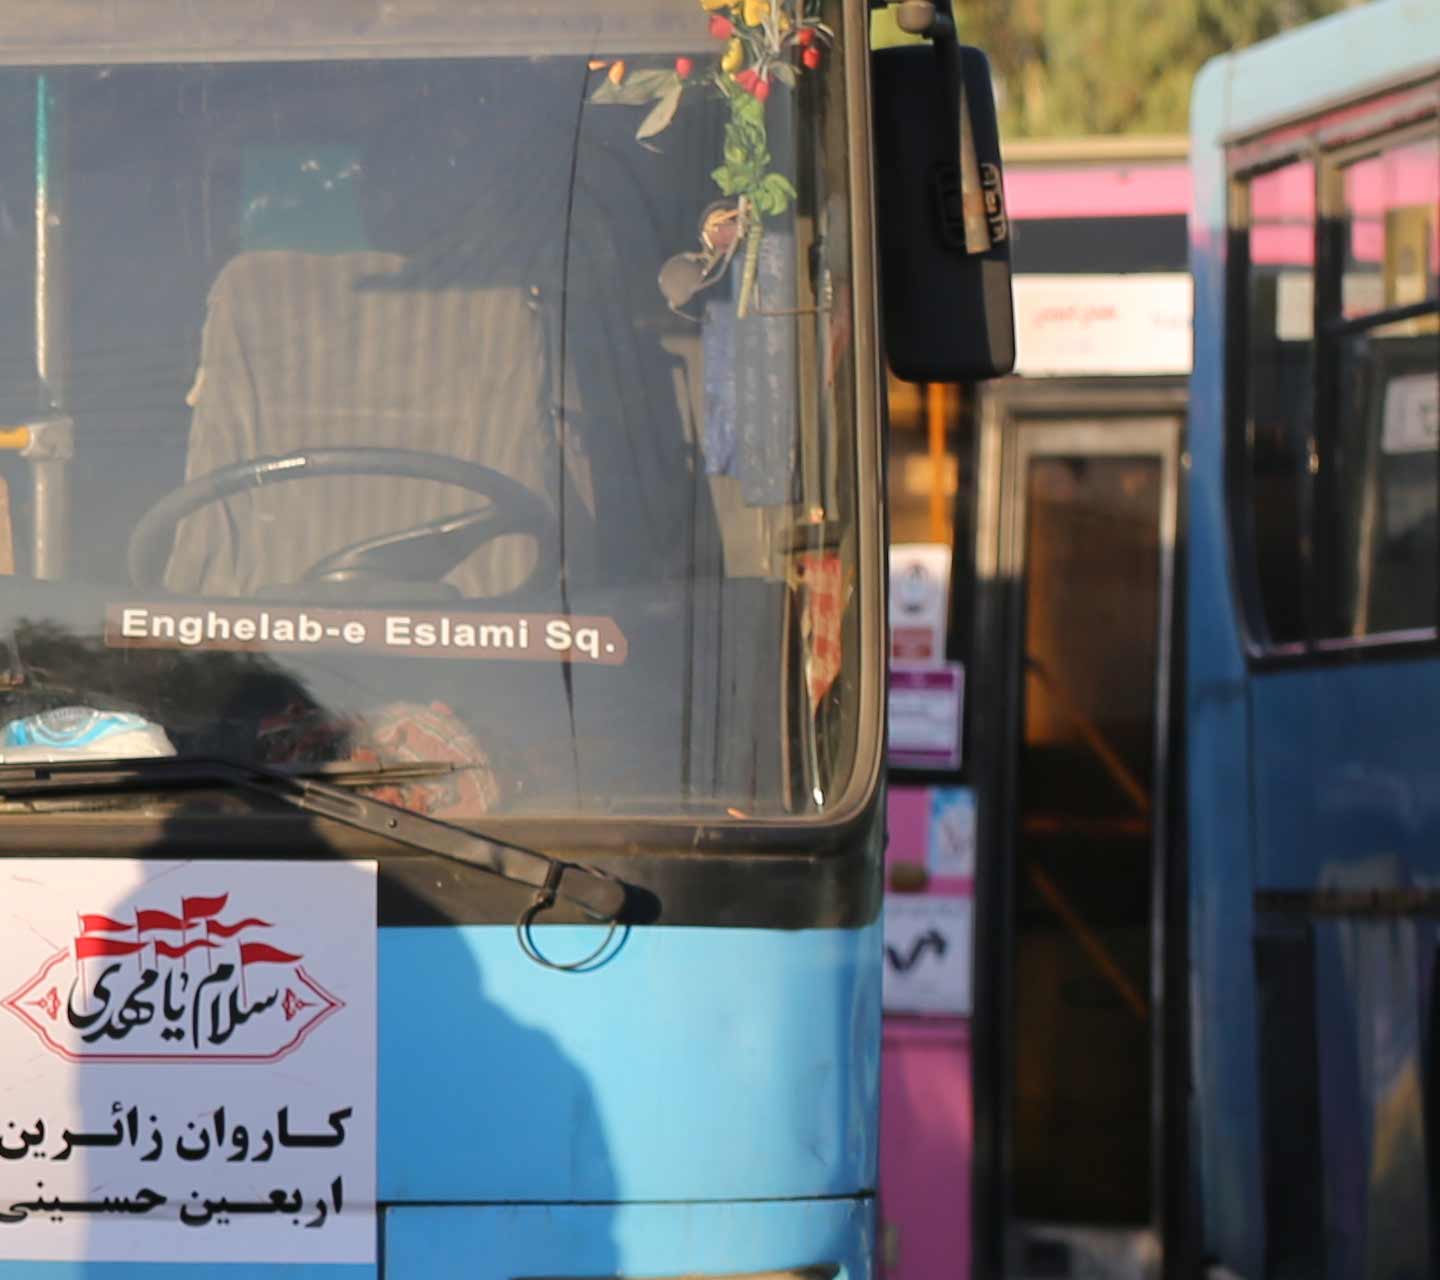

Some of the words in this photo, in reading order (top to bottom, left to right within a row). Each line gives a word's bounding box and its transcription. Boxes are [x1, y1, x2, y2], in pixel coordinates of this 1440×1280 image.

[120, 607, 367, 646] Enghelab-e
[385, 616, 530, 649] Eslami
[544, 619, 616, 660] Sq.
[176, 1105, 353, 1162] کاروان
[179, 1175, 343, 1227] اربعین
